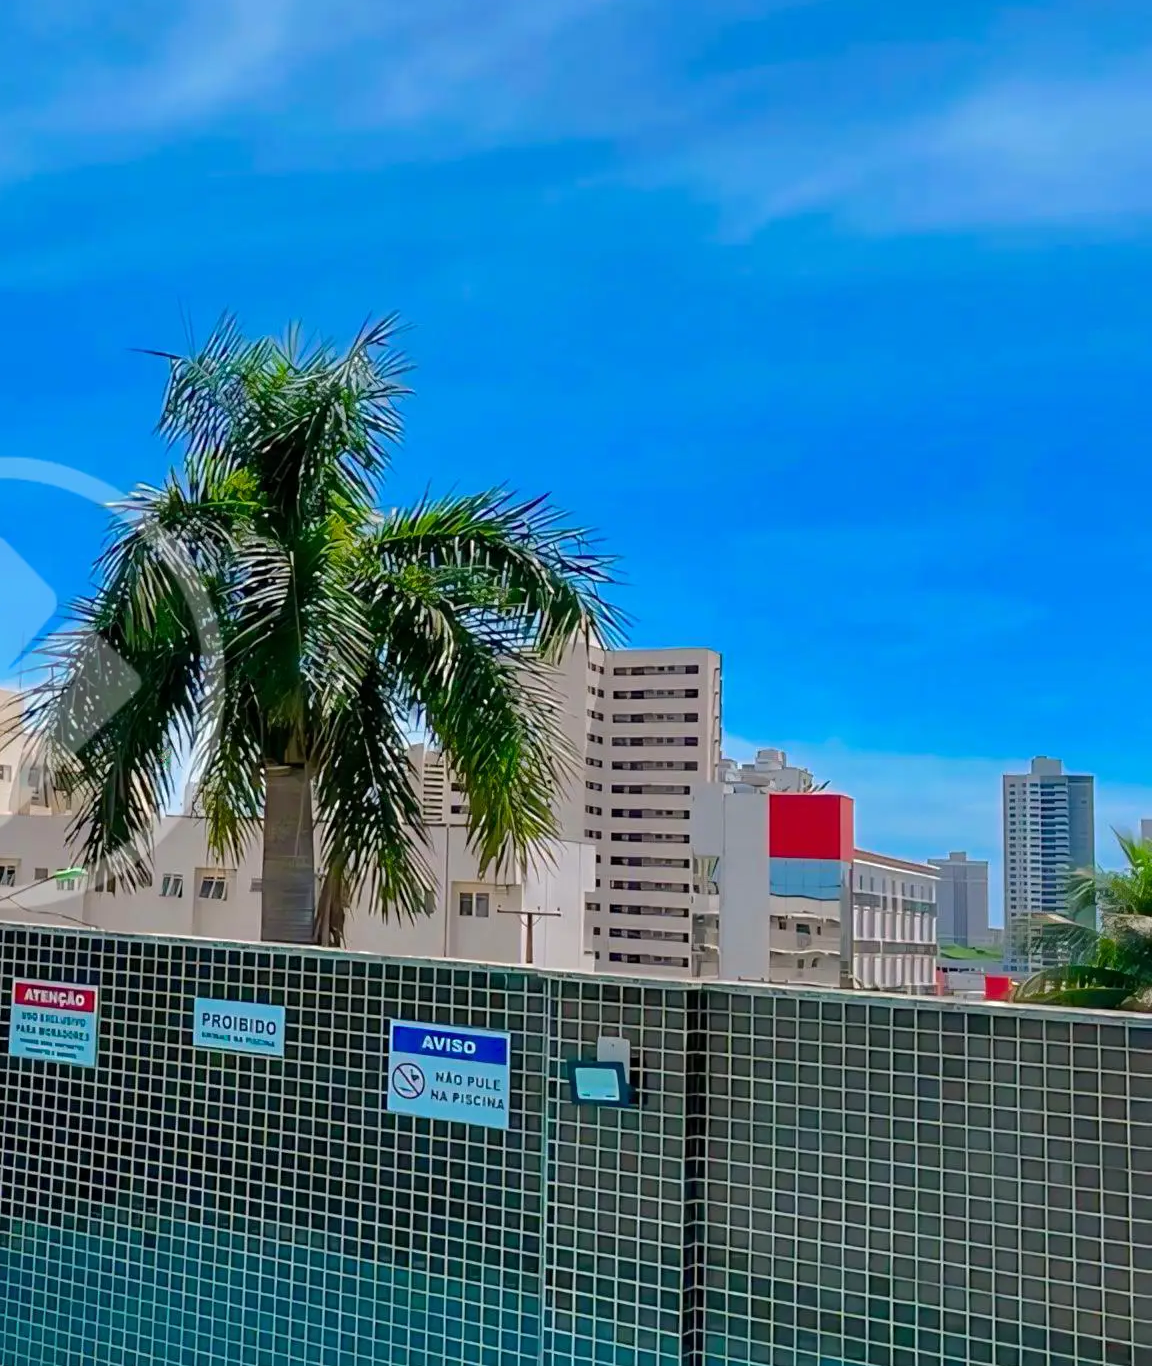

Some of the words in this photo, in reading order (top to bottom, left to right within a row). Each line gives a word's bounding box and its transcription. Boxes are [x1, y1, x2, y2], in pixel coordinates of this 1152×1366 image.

[24, 988, 85, 1007] ATENÇÃO
[16, 1024, 36, 1034] PARA
[202, 1012, 276, 1035] PROIBIDO
[421, 1035, 476, 1054] AVISO
[435, 1070, 463, 1086] NÃO
[468, 1076, 501, 1091] PULE
[431, 1089, 448, 1102] NA
[452, 1092, 505, 1110] PISCINA
